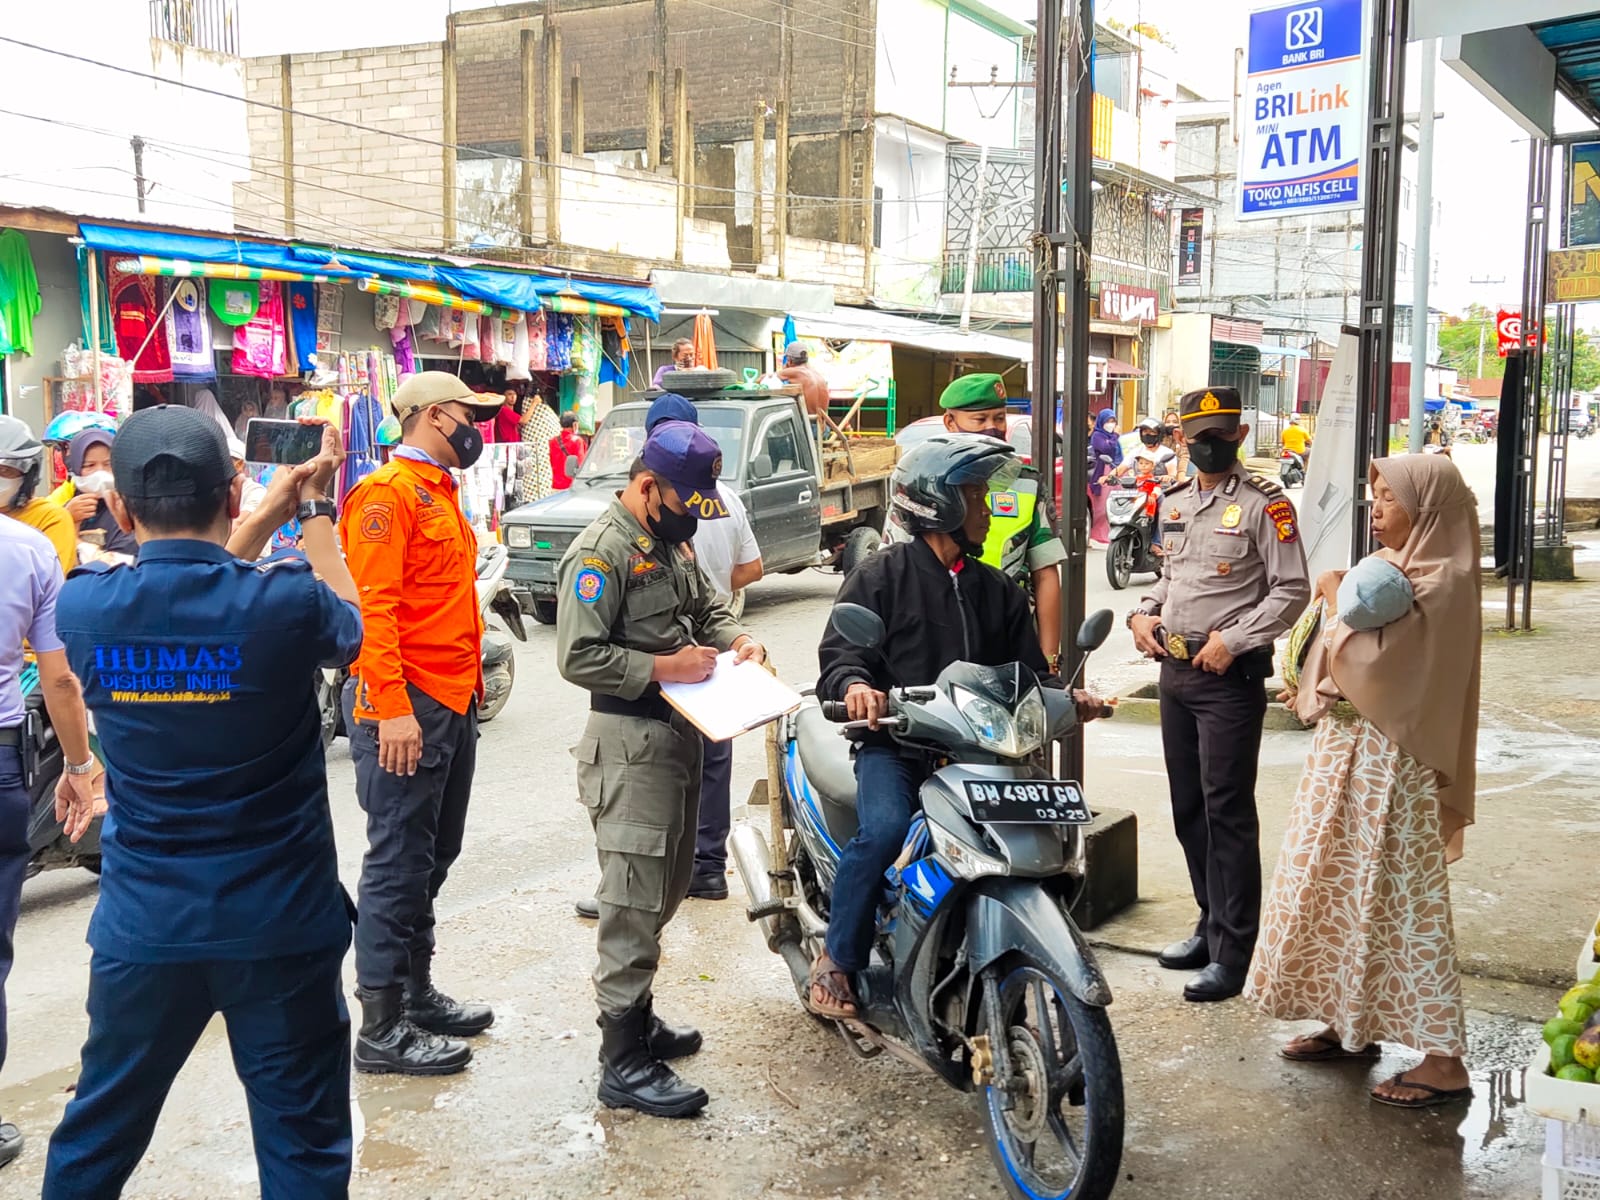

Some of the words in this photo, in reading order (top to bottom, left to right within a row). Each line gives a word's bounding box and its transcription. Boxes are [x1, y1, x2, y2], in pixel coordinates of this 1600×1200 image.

[1282, 52, 1307, 65] BANK
[1309, 47, 1325, 60] BRI
[1256, 81, 1282, 94] Agen
[1255, 84, 1349, 120] BRILink
[1256, 122, 1279, 136] MINI
[1260, 124, 1342, 170] ATM
[1247, 186, 1282, 203] TOKO
[1283, 181, 1321, 199] NAFIS
[1322, 178, 1354, 194] CELL
[685, 491, 728, 517] POL
[94, 645, 243, 673] HUMAS
[101, 674, 176, 689] DISHUB
[187, 673, 240, 689] INHIL
[970, 783, 1000, 802] BM
[1003, 783, 1050, 803] 4987
